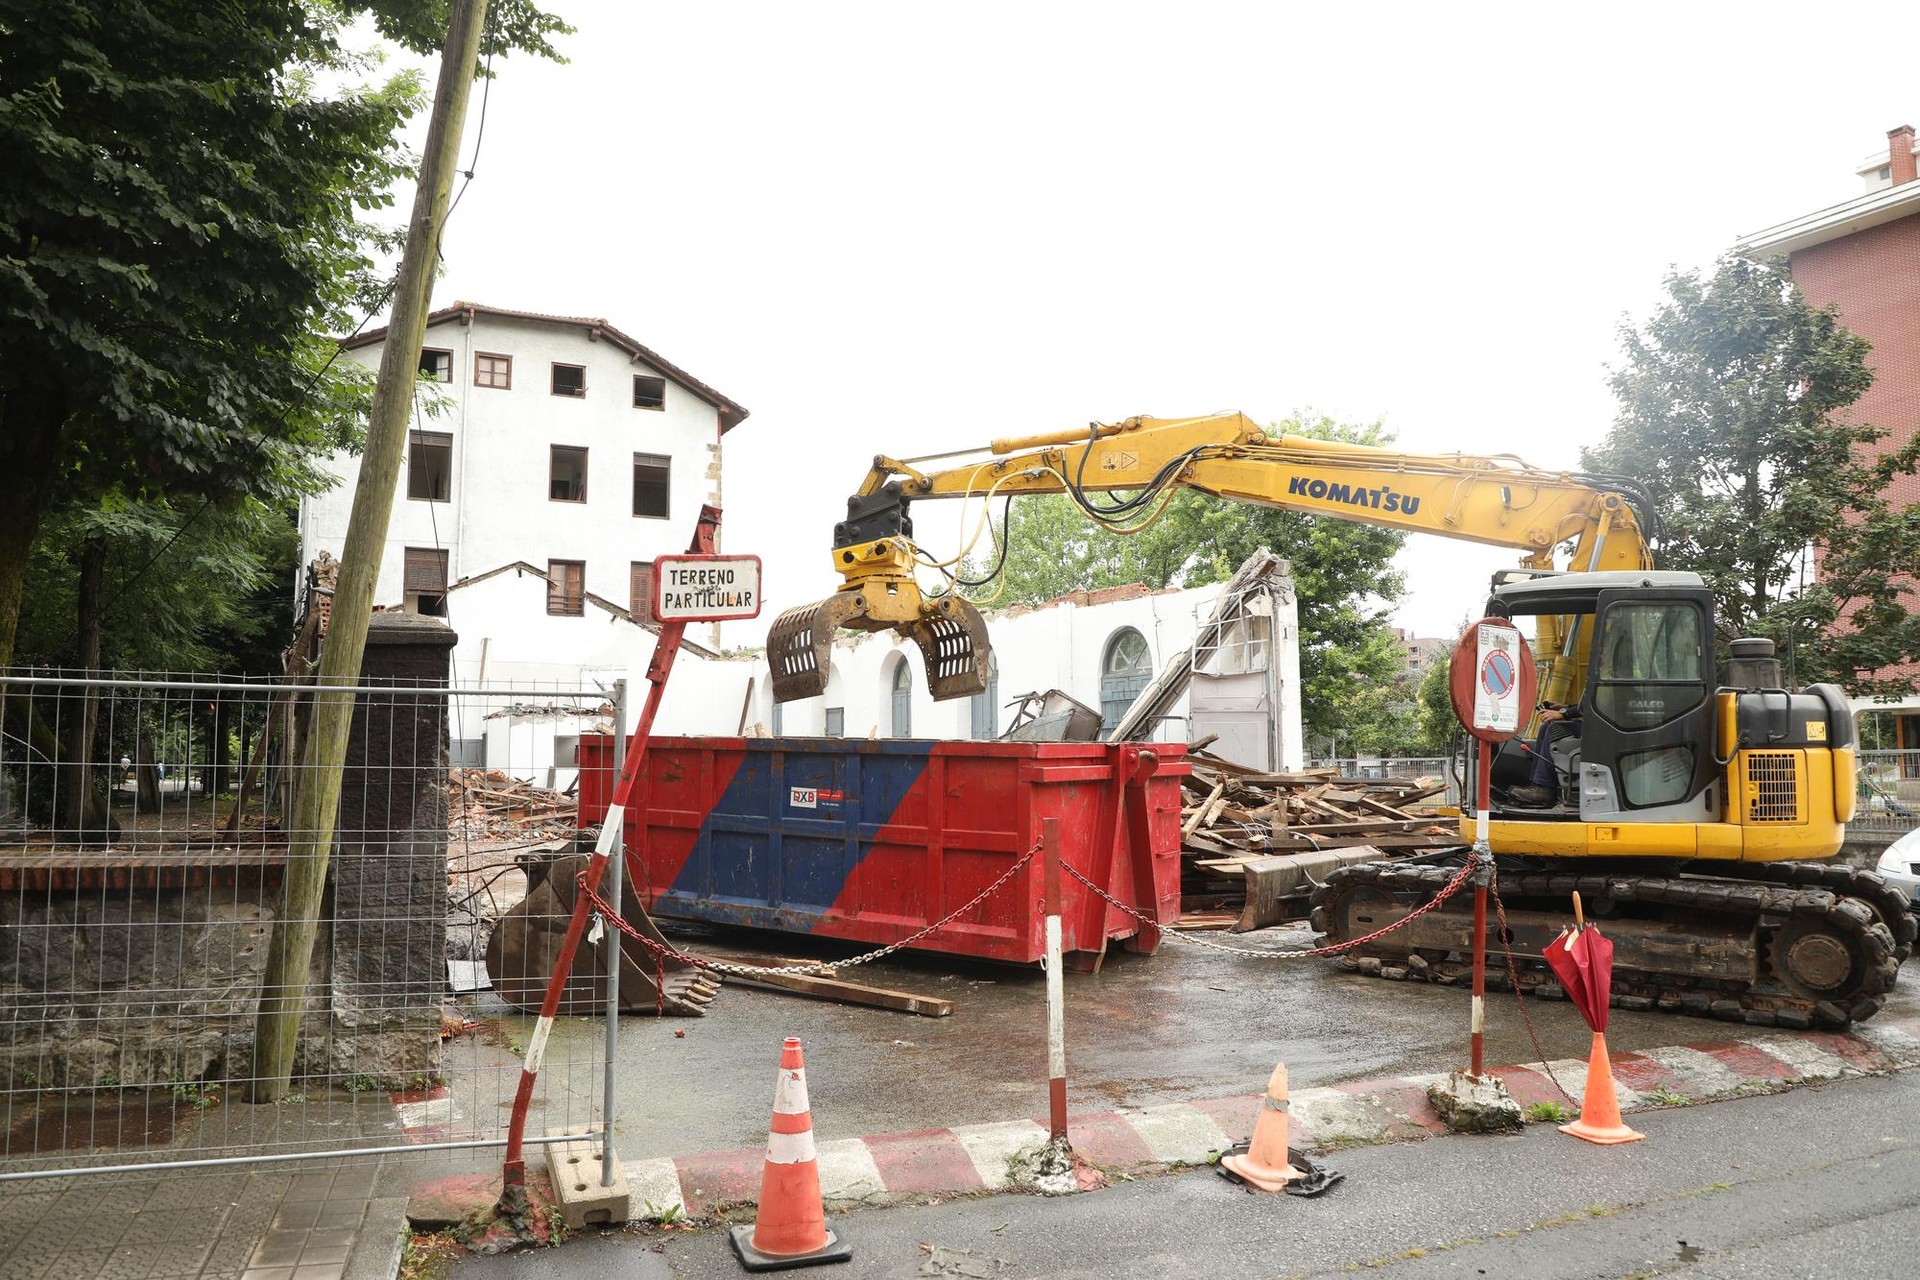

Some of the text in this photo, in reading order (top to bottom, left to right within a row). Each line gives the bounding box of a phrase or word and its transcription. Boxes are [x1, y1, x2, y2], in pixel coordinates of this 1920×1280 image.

[1288, 476, 1420, 515] KOMATSU
[669, 569, 735, 586] TERRENO
[665, 591, 752, 609] PARTICULAR
